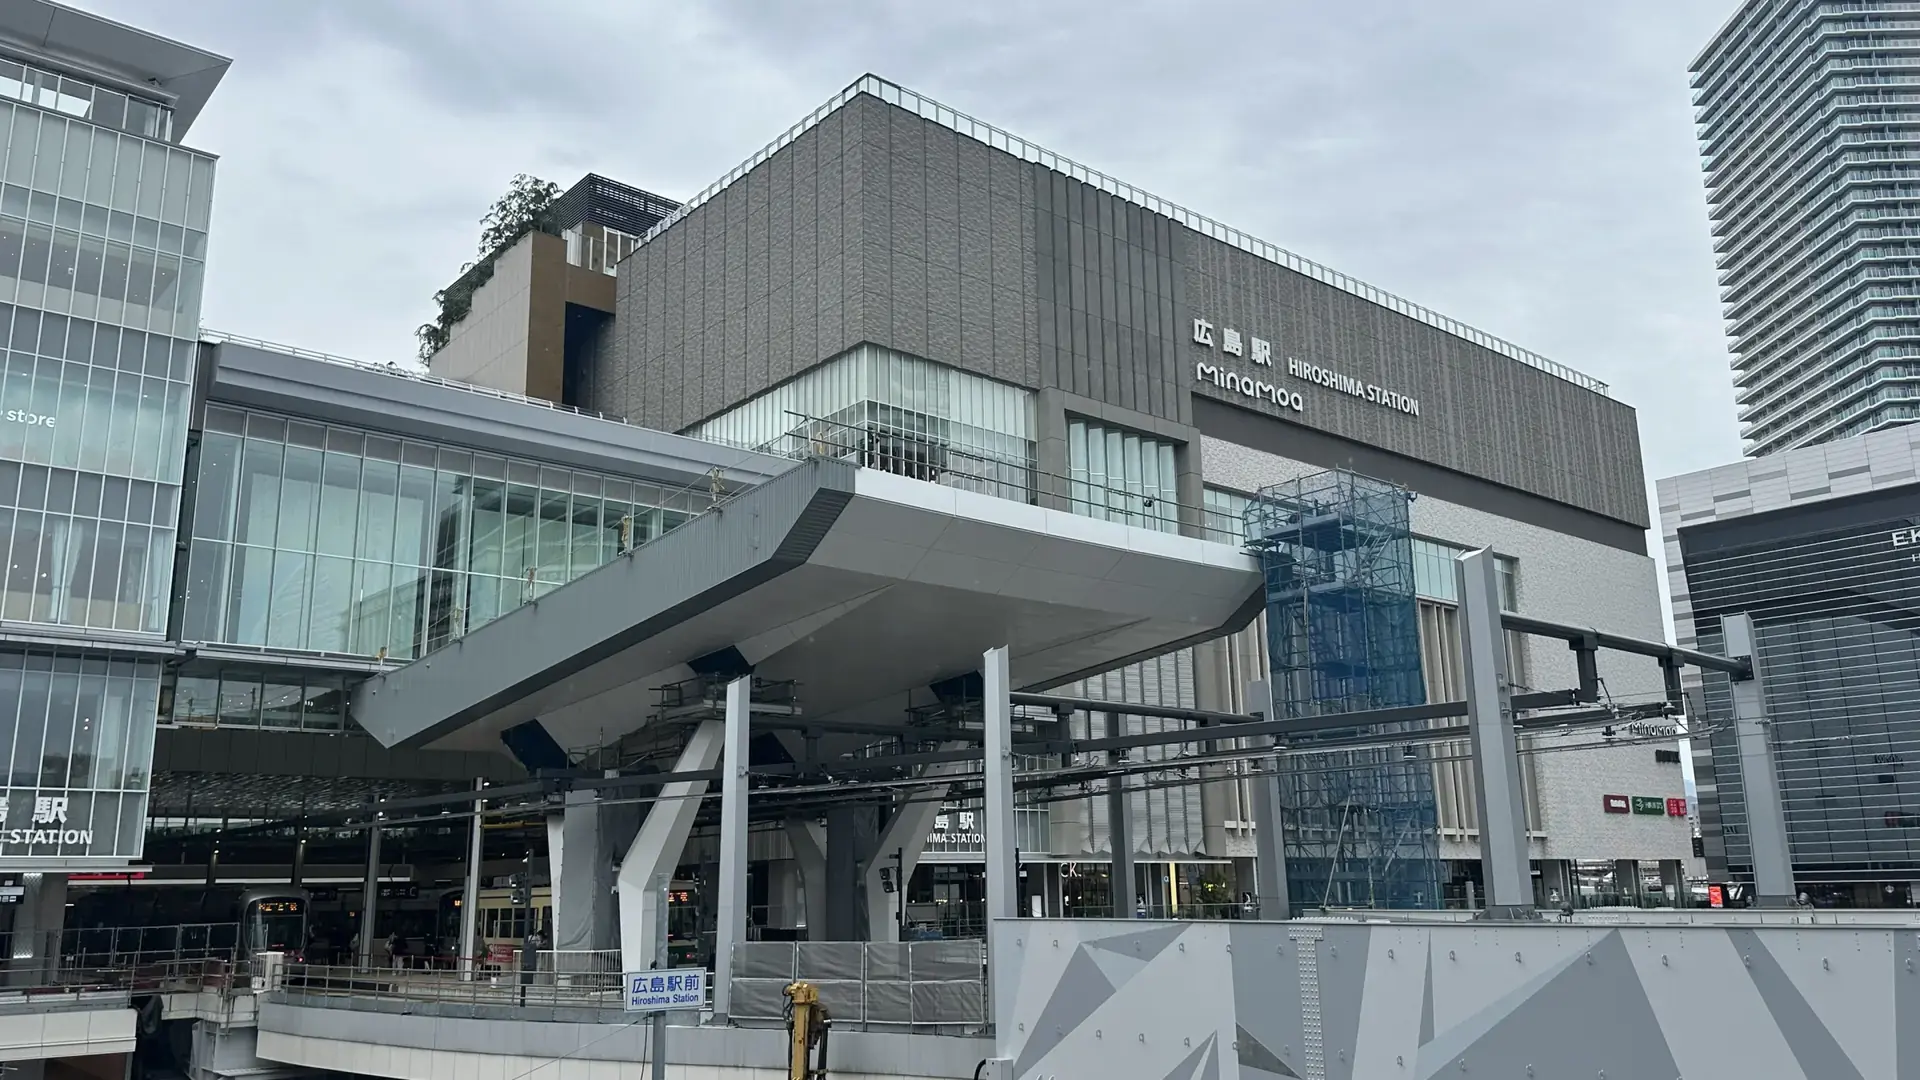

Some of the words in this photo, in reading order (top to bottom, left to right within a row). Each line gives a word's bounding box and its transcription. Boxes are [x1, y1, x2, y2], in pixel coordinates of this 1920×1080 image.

[1193, 318, 1272, 367] 広島駅
[1288, 356, 1366, 399] HIROSHIMA
[1367, 383, 1419, 417] STATION
[6, 409, 56, 428] store
[0, 797, 69, 824] 駅
[10, 828, 94, 845] STATION
[632, 974, 700, 994] 広島駅前
[631, 996, 670, 1006] Hiroshima
[673, 993, 699, 1004] Station
